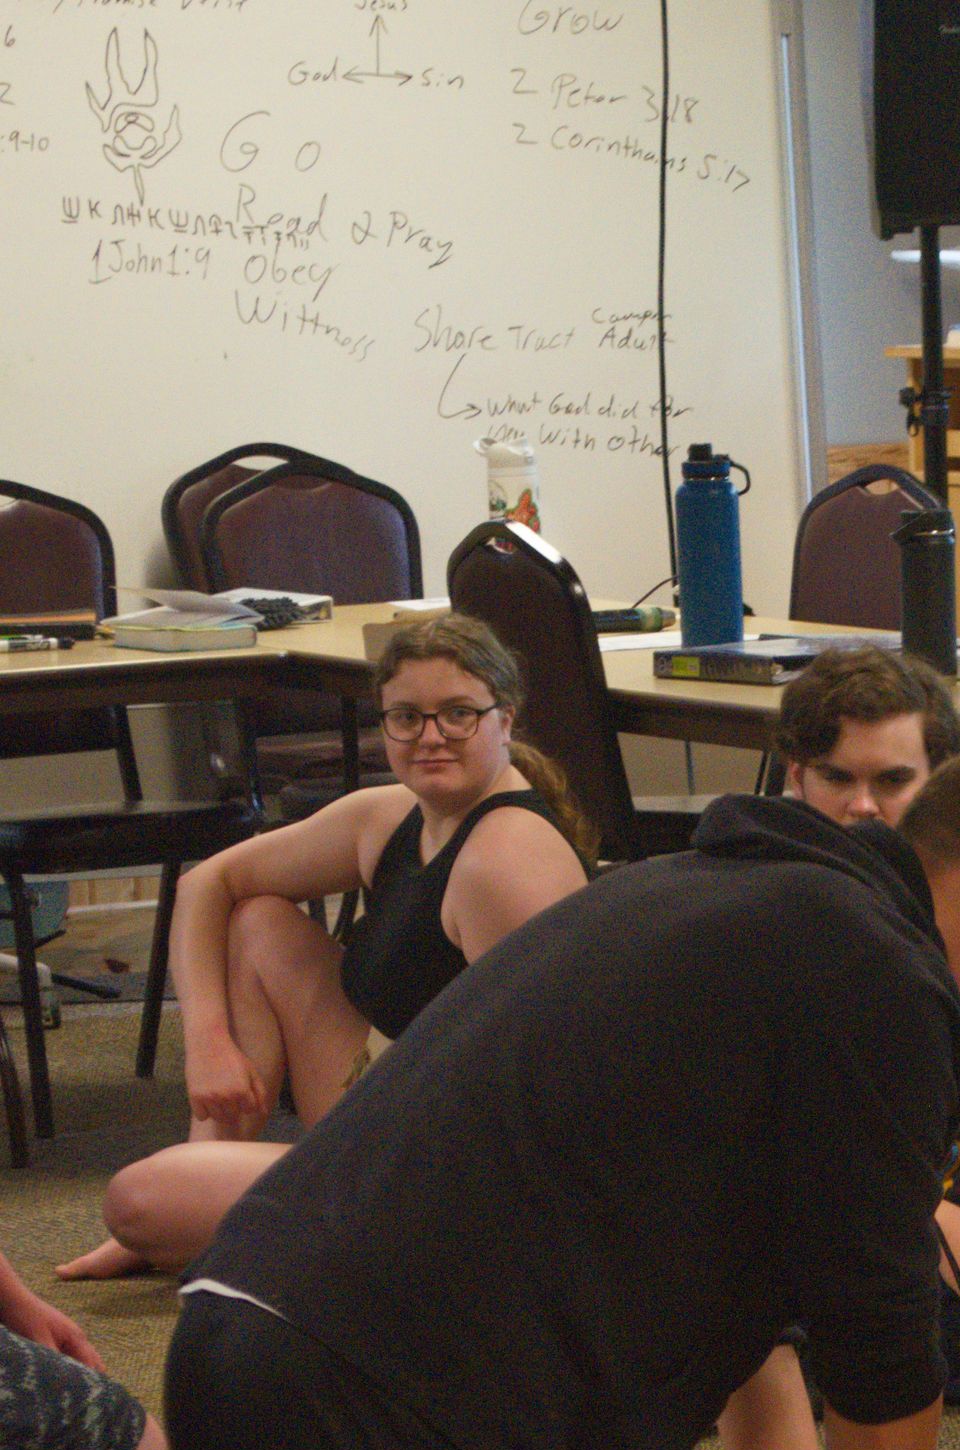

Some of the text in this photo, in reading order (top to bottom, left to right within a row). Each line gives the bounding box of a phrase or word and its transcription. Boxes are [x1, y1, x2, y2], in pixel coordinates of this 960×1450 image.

[517, 0, 624, 35] Grow
[287, 56, 339, 86] God
[510, 67, 539, 94] 2
[511, 123, 538, 145] 2
[387, 210, 453, 270] Pray
